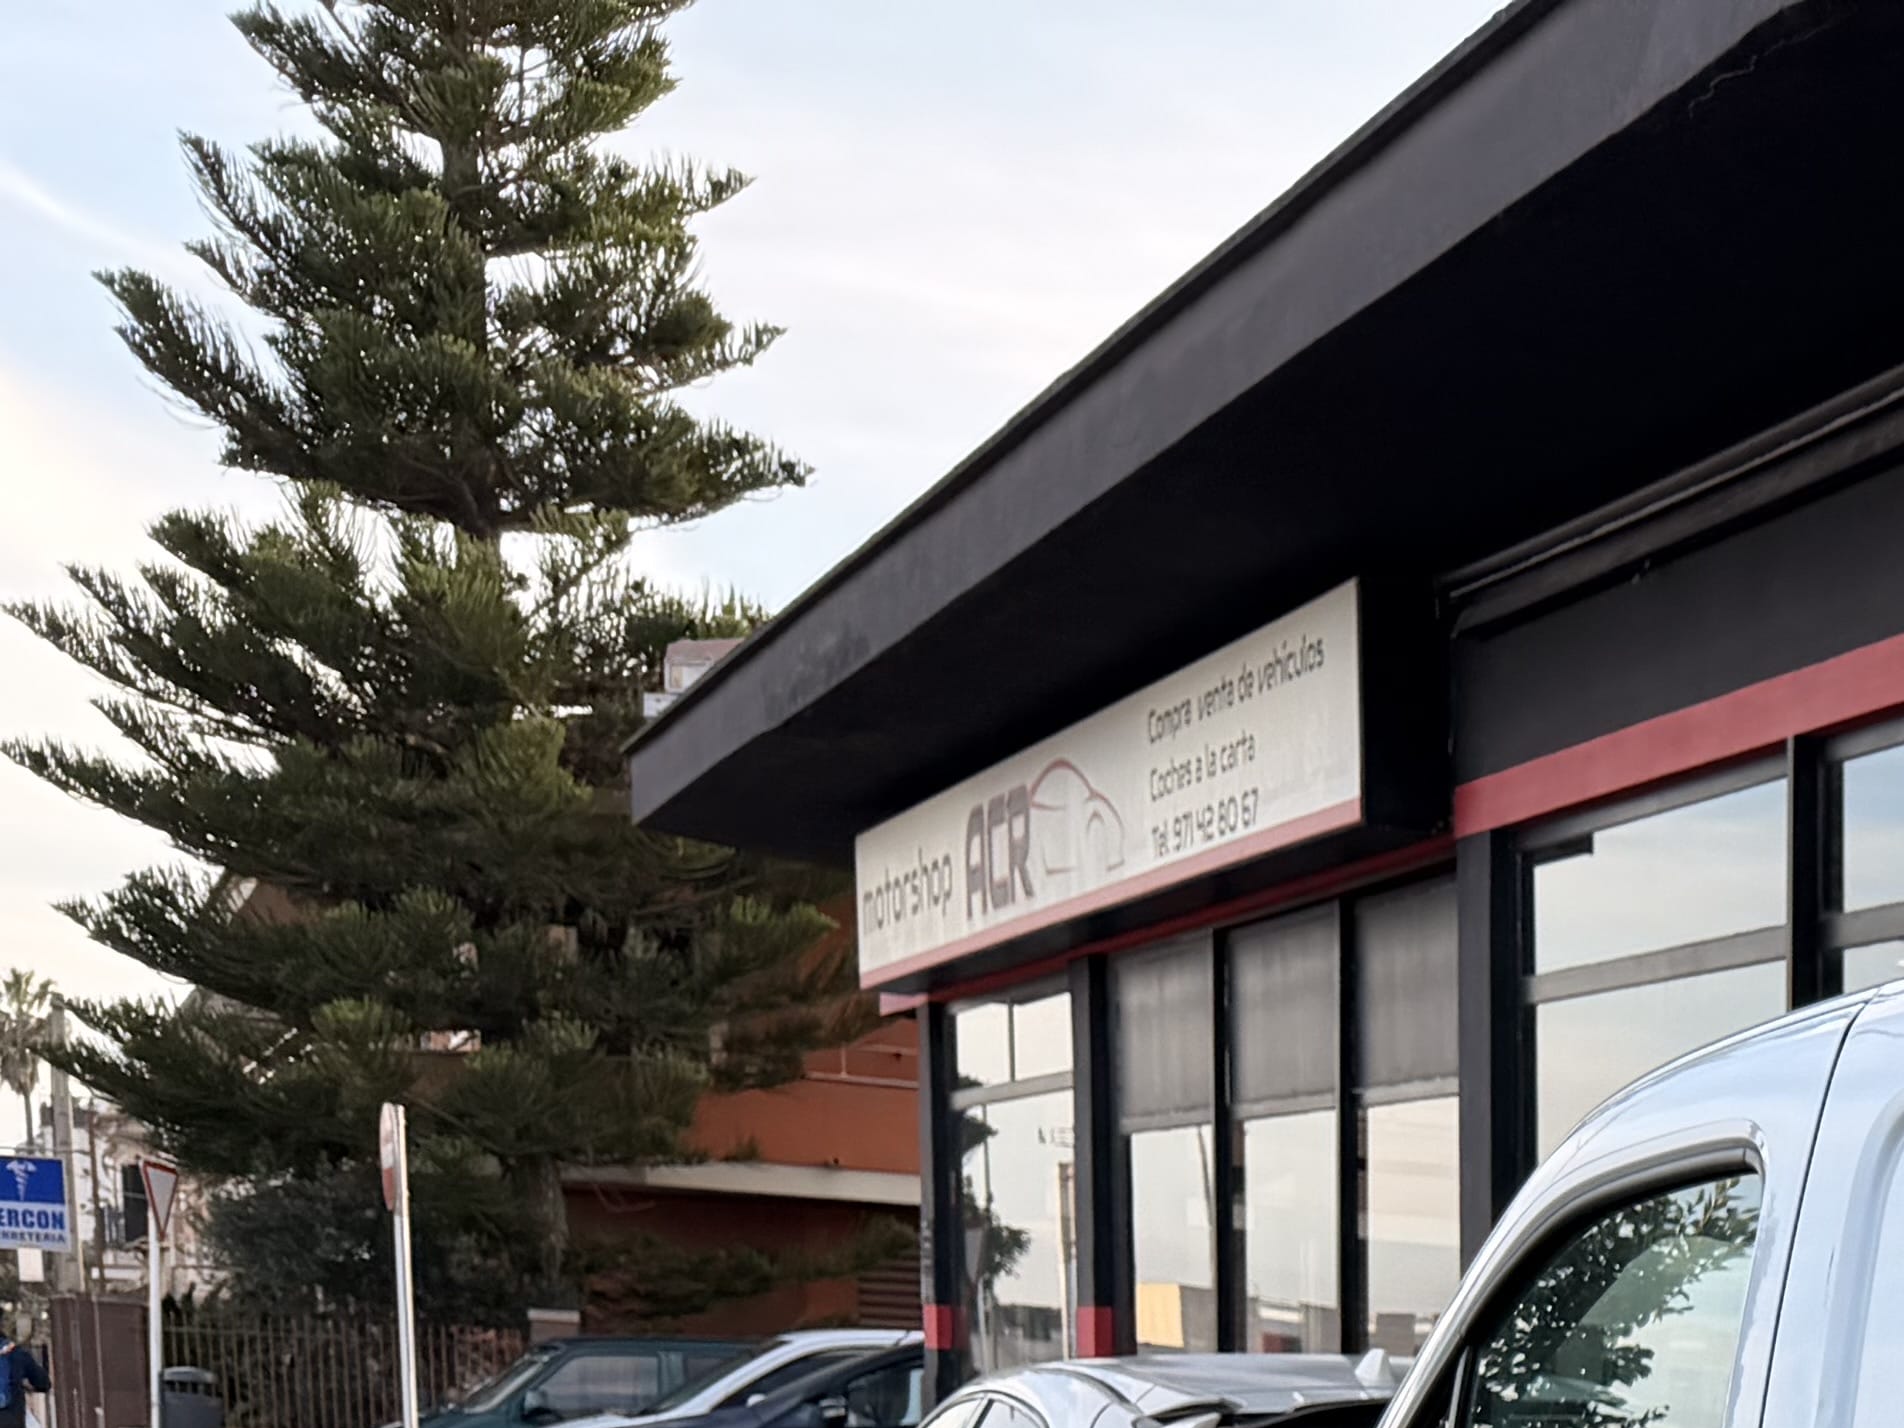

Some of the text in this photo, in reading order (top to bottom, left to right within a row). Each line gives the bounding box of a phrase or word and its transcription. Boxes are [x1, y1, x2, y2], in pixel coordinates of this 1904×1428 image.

[1148, 633, 1325, 744] Compra venta de vehículos
[1150, 728, 1255, 802] Coches a la carta
[862, 783, 1035, 935] motorshop ACR
